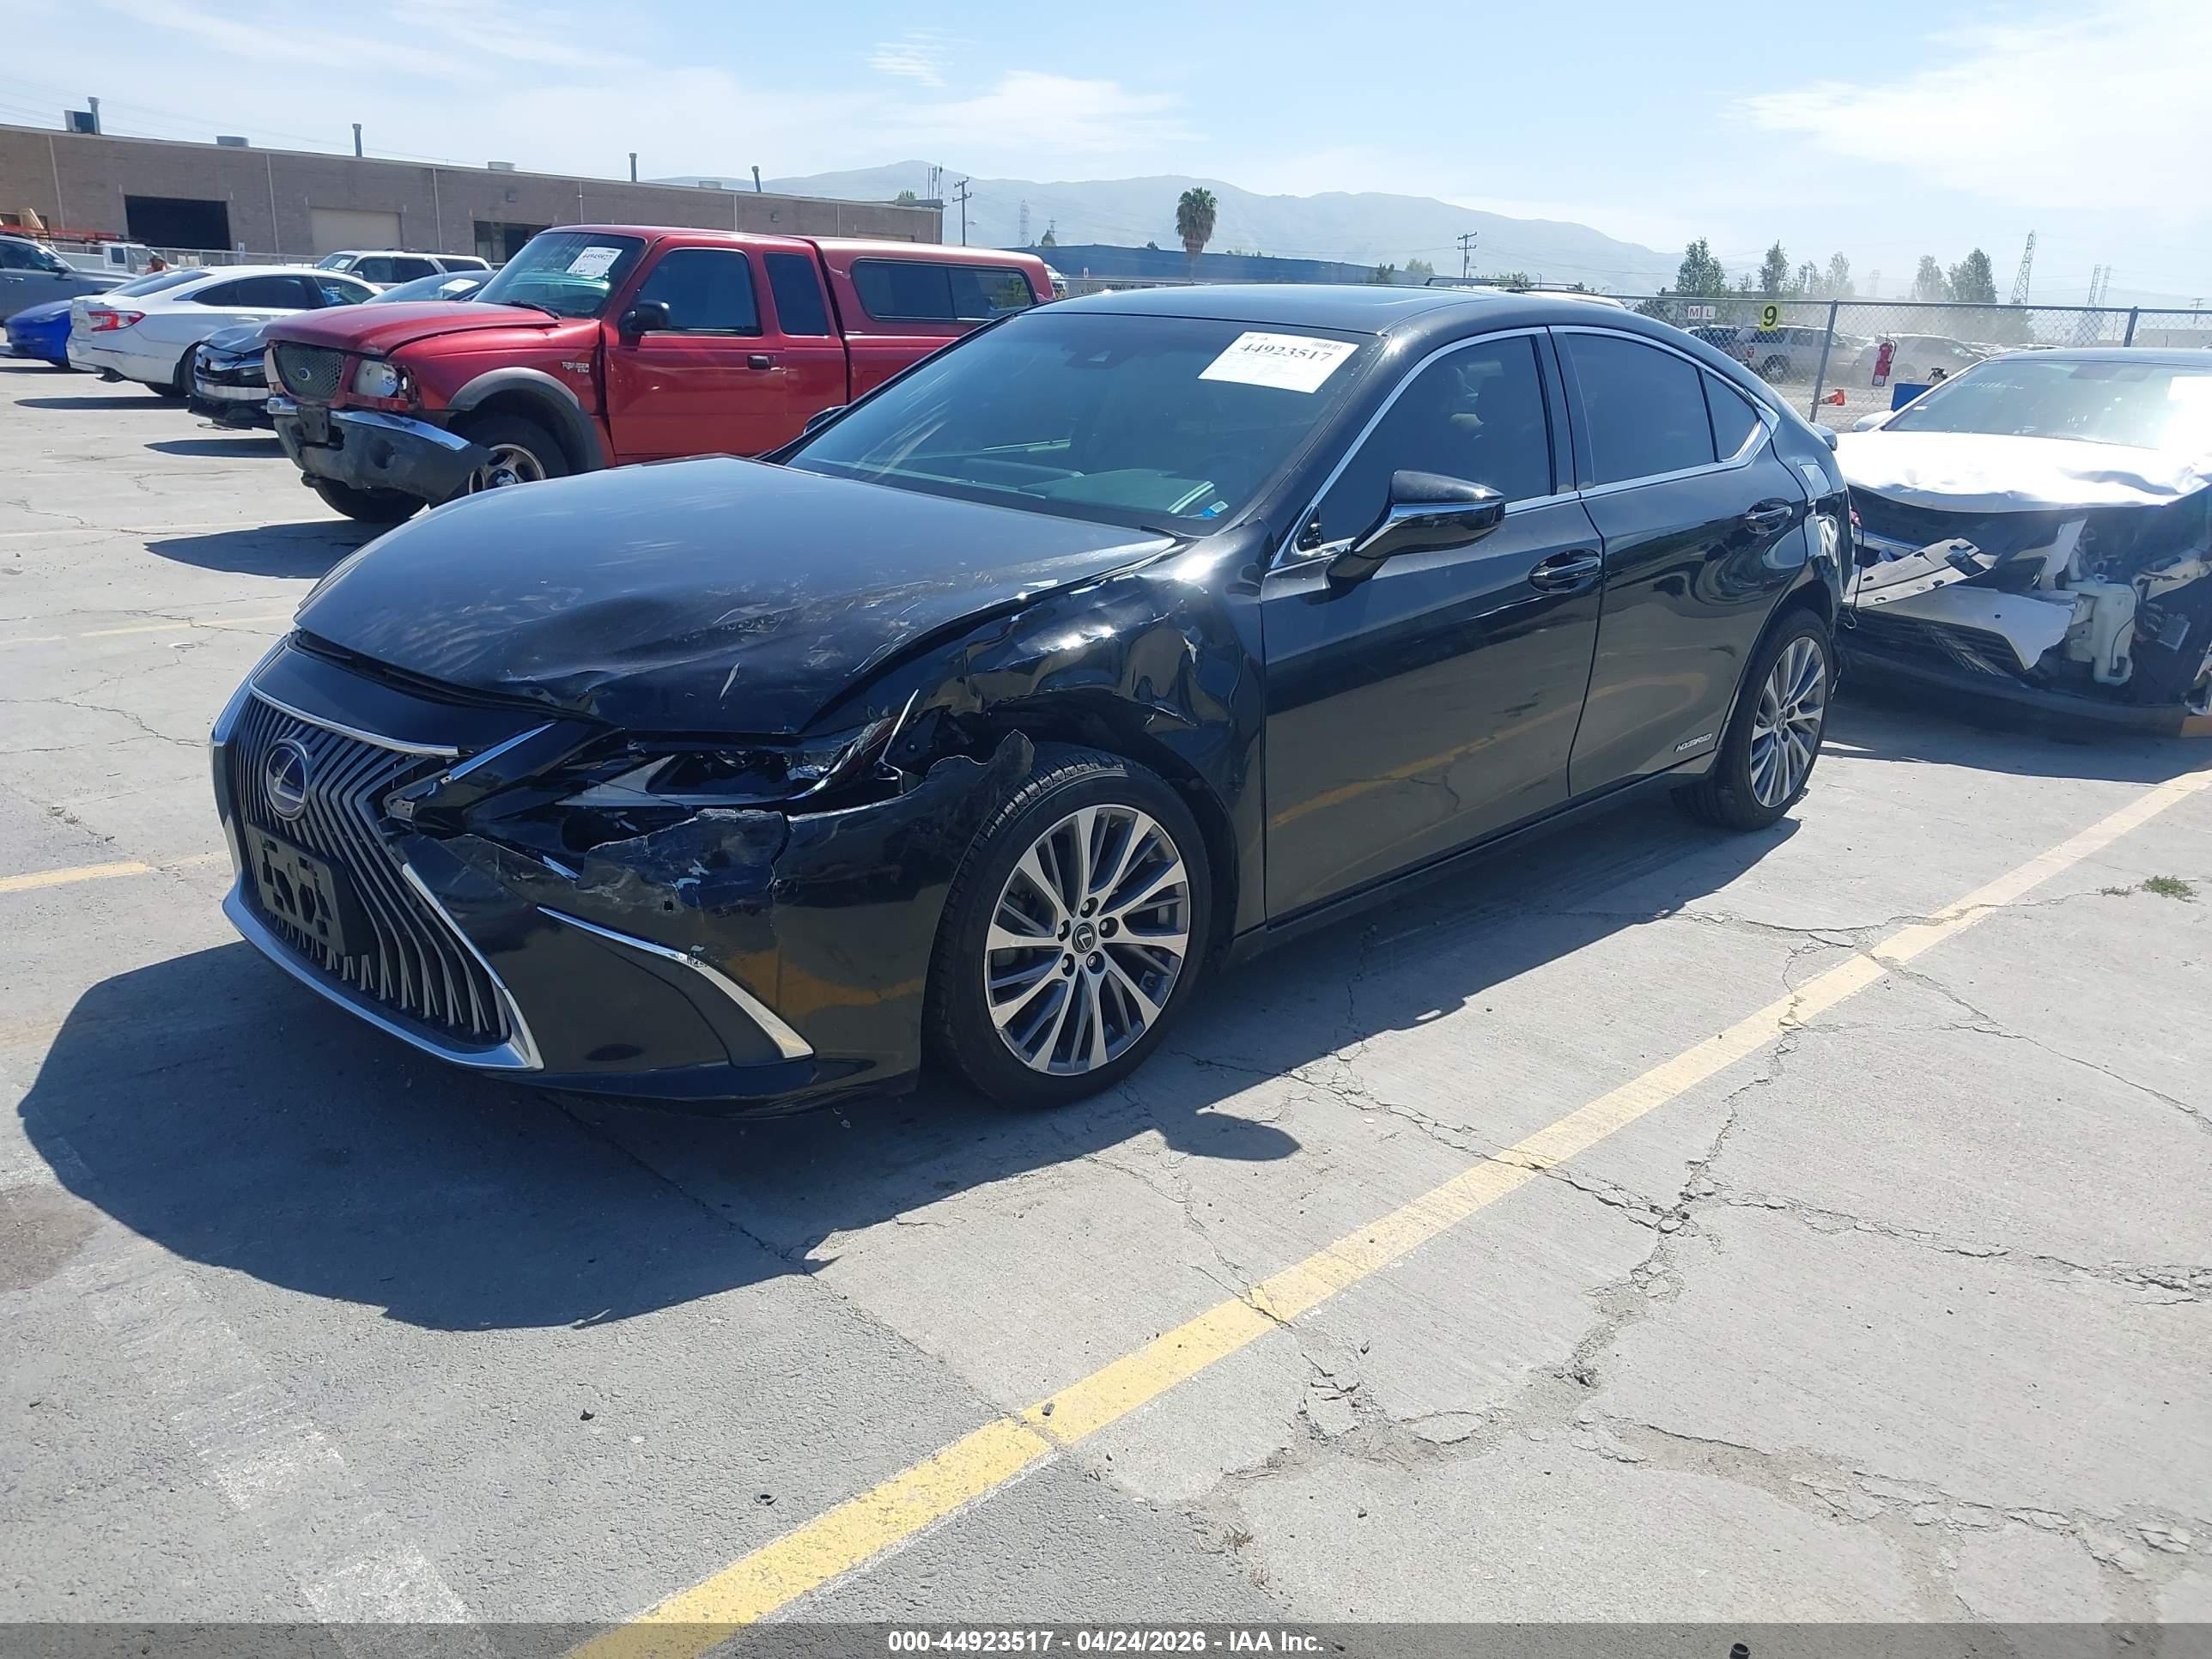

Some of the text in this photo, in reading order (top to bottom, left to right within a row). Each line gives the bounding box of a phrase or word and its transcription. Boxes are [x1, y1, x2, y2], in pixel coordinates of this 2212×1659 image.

[1763, 305, 1778, 327] 9
[1239, 343, 1334, 362] 44923517
[1675, 733, 1712, 752] HYBRID
